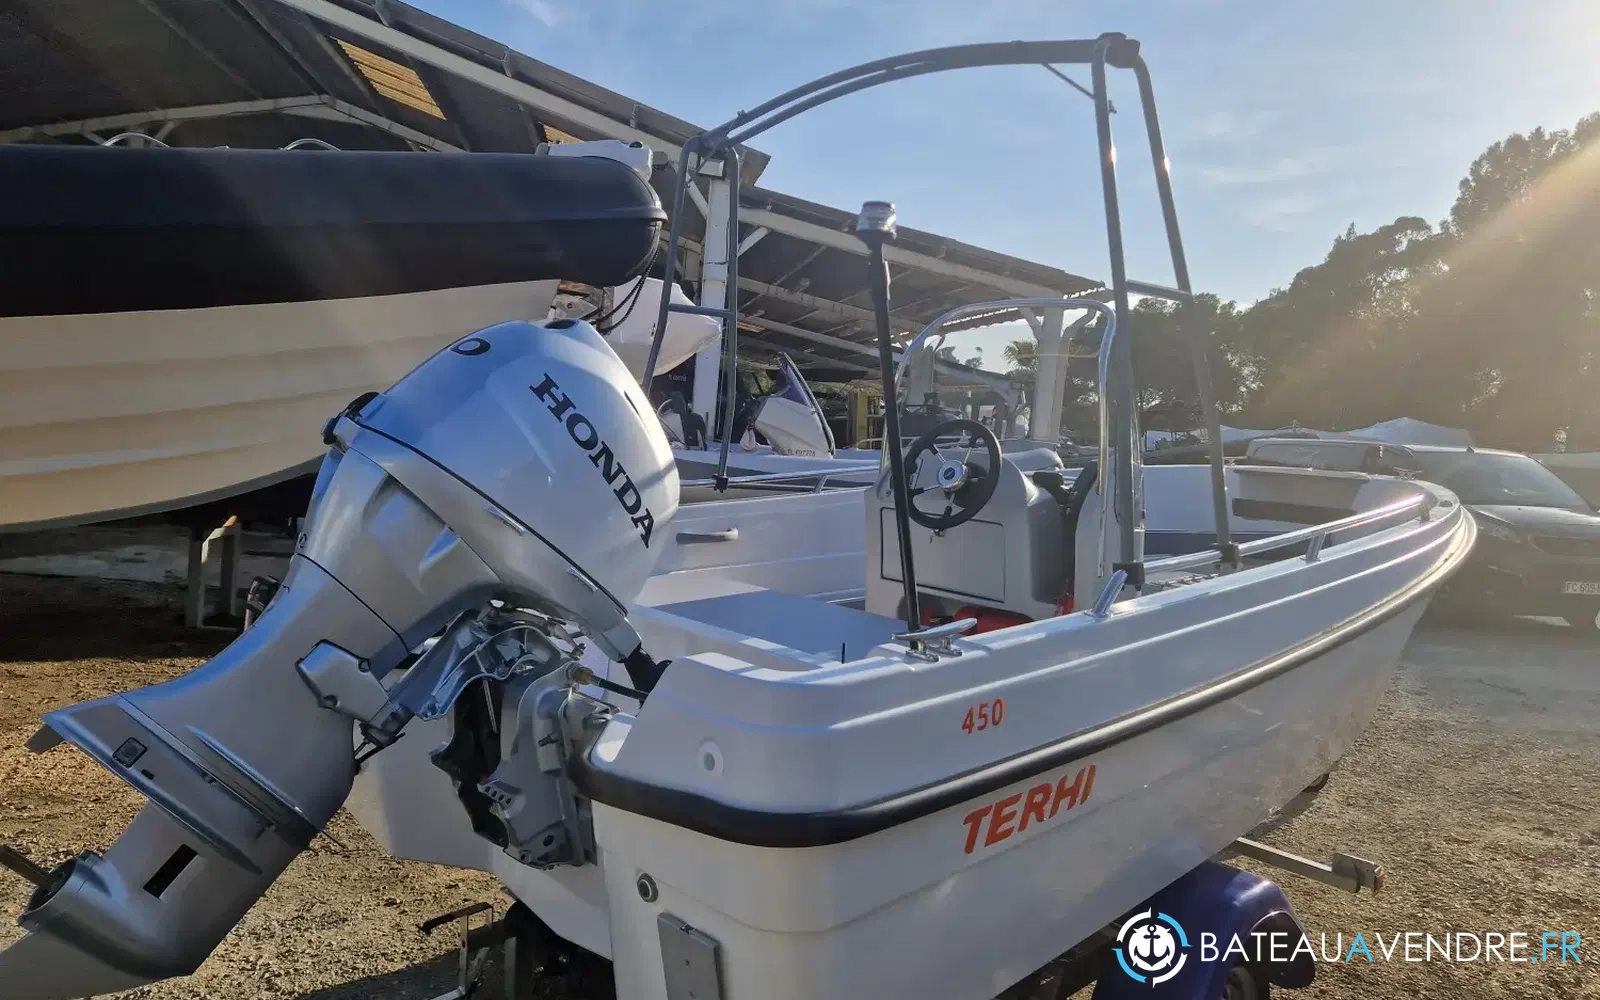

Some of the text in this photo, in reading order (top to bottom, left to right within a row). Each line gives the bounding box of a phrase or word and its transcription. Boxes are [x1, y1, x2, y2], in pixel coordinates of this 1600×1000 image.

[529, 373, 654, 549] HONDA
[962, 698, 1003, 734] 450
[963, 765, 1096, 854] TERHI
